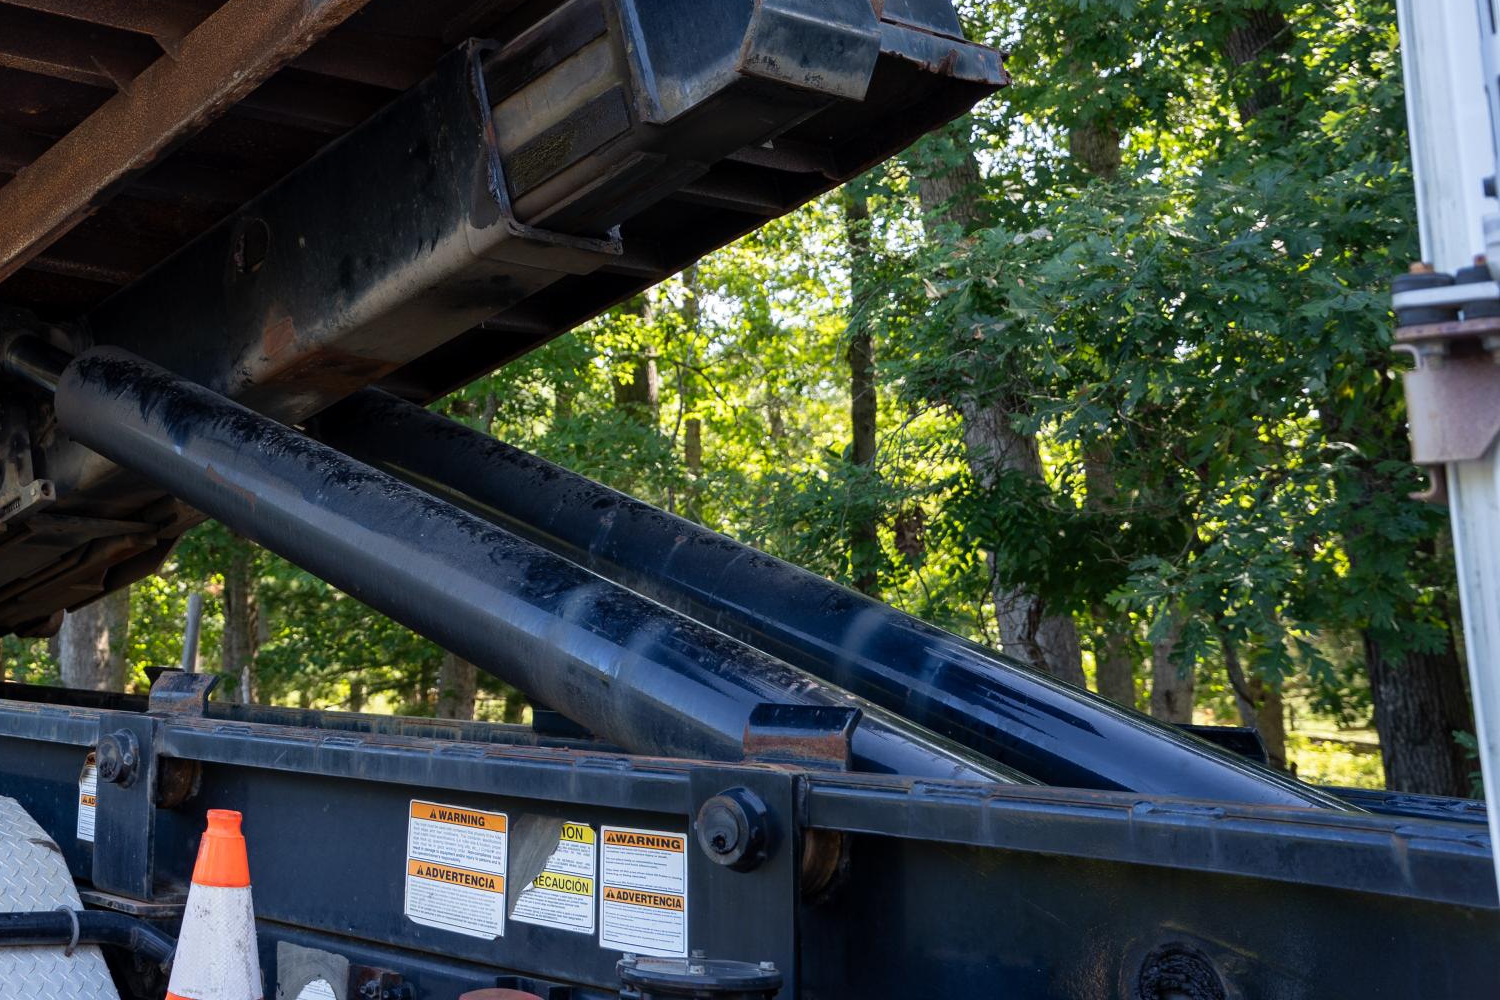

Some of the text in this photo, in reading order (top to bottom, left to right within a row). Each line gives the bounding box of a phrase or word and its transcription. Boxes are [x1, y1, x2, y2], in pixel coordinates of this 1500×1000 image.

[438, 810, 485, 827] WARNING
[615, 833, 681, 850] WARNING
[425, 866, 496, 890] ADVERTENCIA
[532, 875, 589, 894] RECAUCIÓN
[616, 890, 682, 909] ADVERTENCIA
